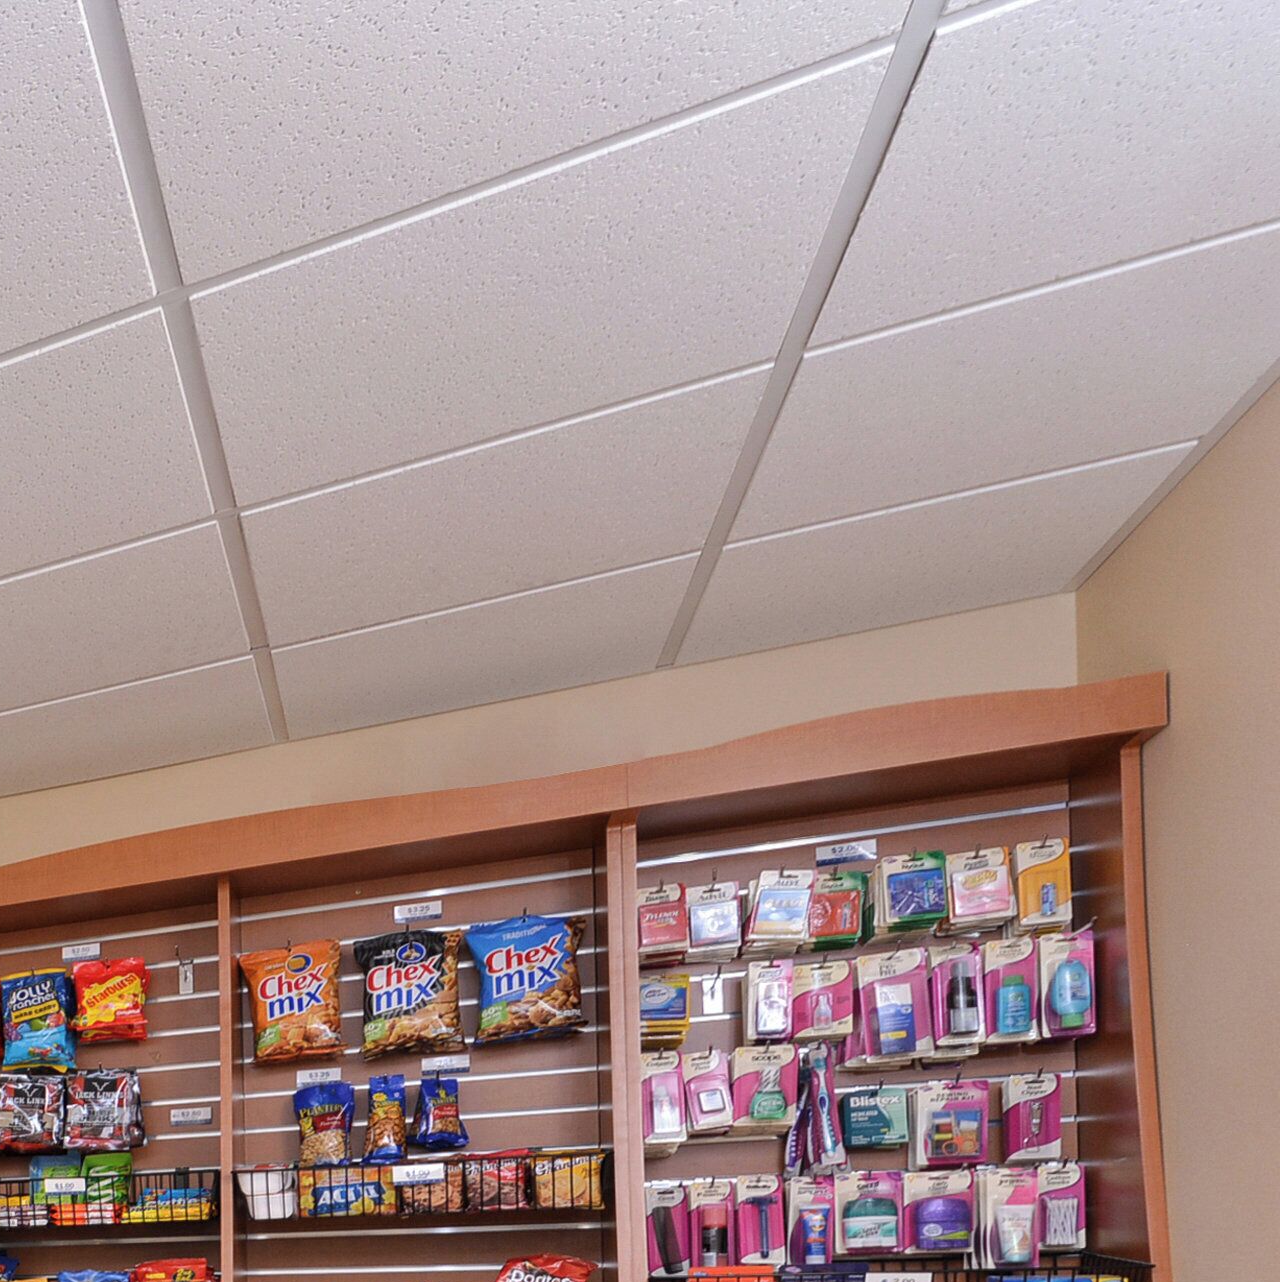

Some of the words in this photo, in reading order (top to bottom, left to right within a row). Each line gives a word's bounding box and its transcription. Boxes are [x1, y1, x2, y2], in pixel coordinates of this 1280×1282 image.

[485, 936, 561, 976] Chex
[9, 980, 52, 1005] JOLLY
[259, 966, 325, 1000] Chex
[367, 960, 438, 994] Chex
[494, 960, 560, 998] mix
[267, 988, 324, 1020] mix
[373, 981, 437, 1016] mix
[751, 1053, 782, 1062] scope
[849, 1094, 900, 1108] Blistex
[317, 1186, 356, 1206] ACT
